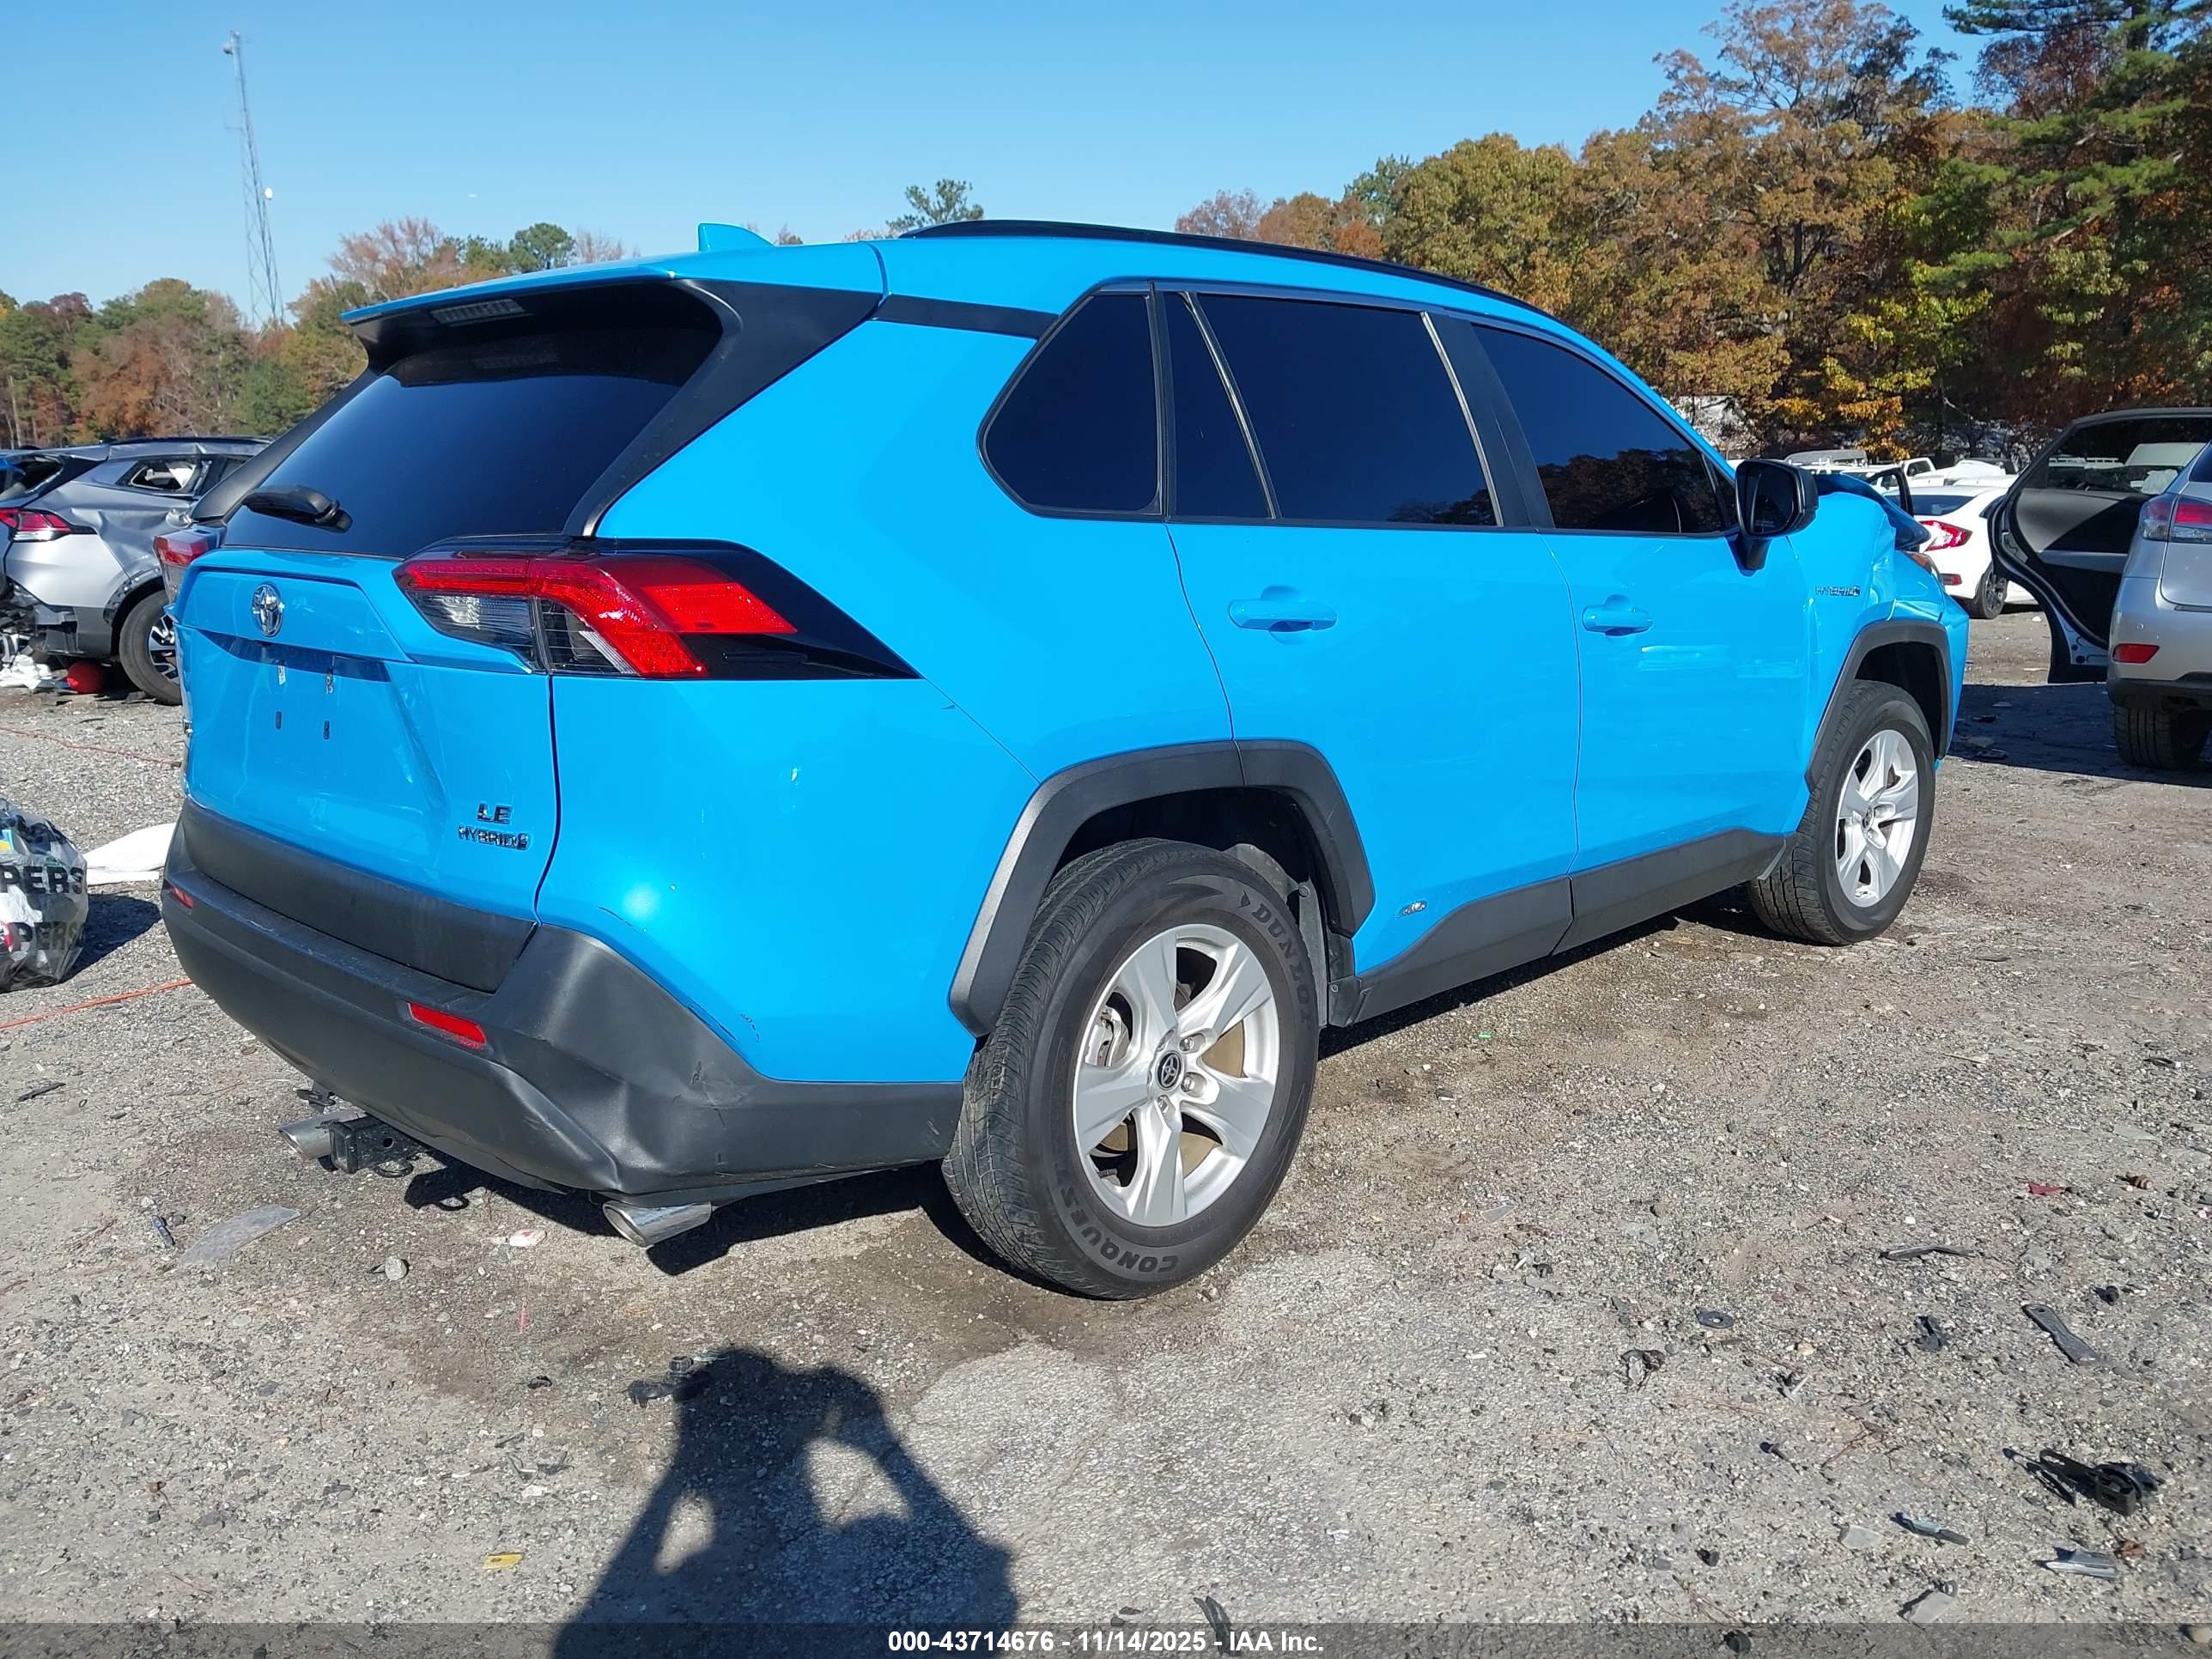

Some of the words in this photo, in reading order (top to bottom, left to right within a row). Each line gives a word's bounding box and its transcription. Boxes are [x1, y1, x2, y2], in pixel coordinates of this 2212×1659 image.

[477, 803, 513, 824] LE
[458, 824, 526, 850] HYBRID
[1251, 903, 1312, 1024] DUNLOP
